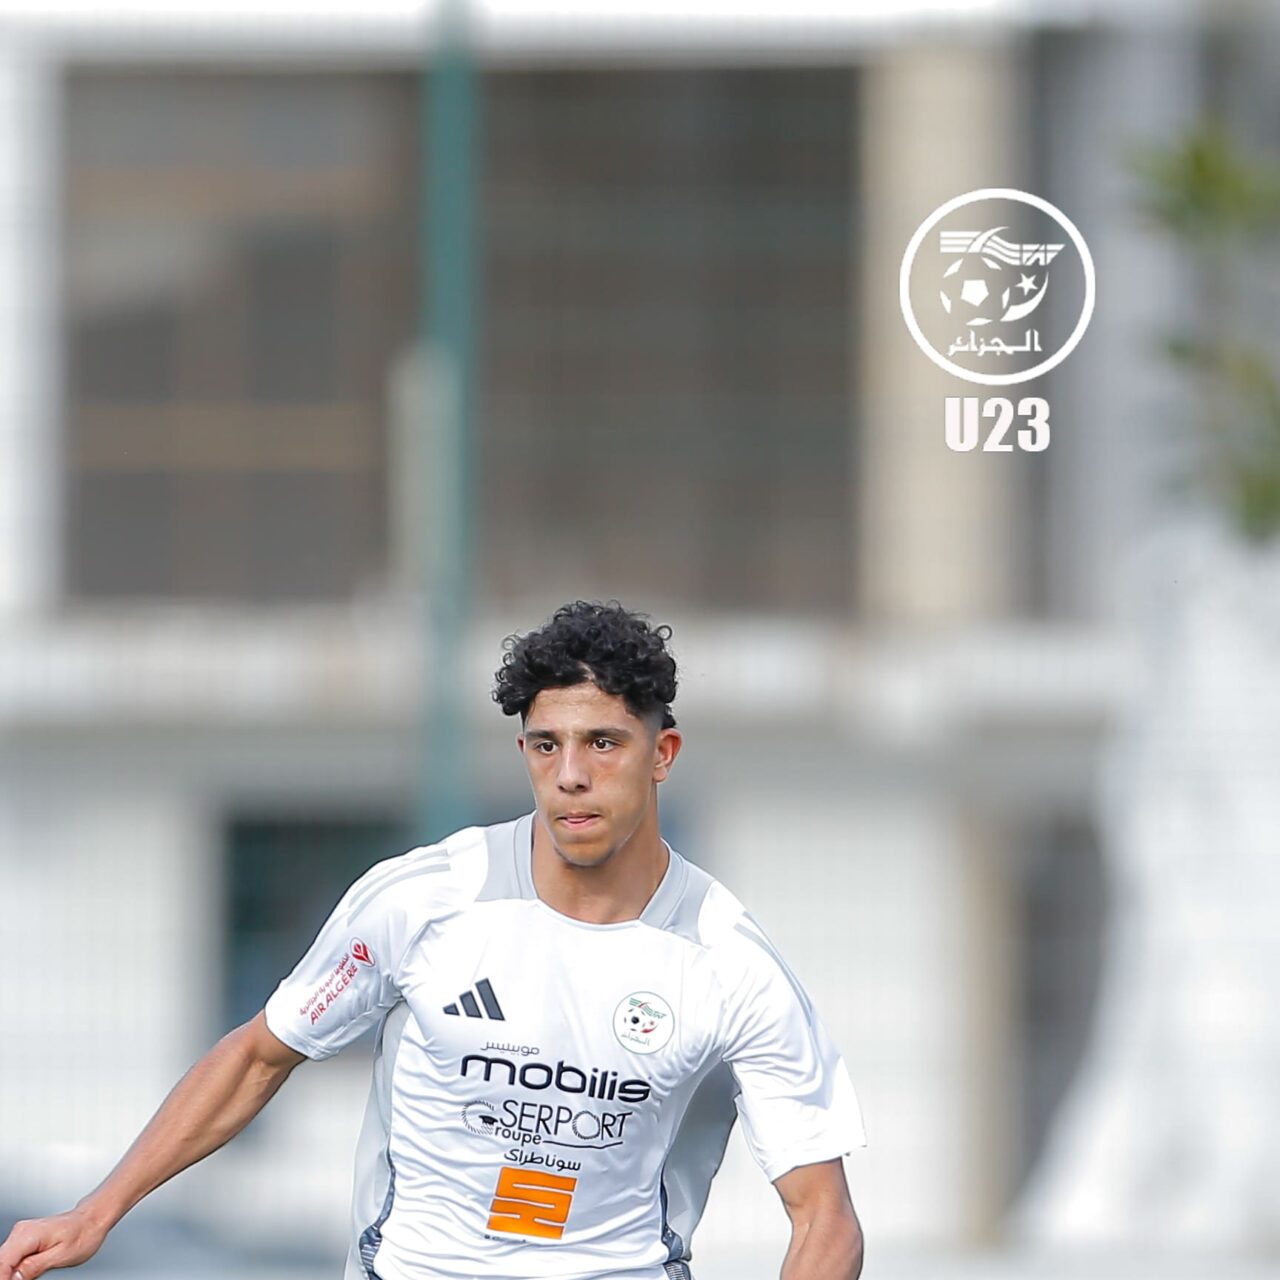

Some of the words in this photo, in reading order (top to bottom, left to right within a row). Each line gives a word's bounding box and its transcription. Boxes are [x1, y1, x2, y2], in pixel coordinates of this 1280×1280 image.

[309, 1001, 327, 1025] AIR
[460, 1054, 651, 1103] mobilis
[499, 1098, 634, 1141] SERPORT
